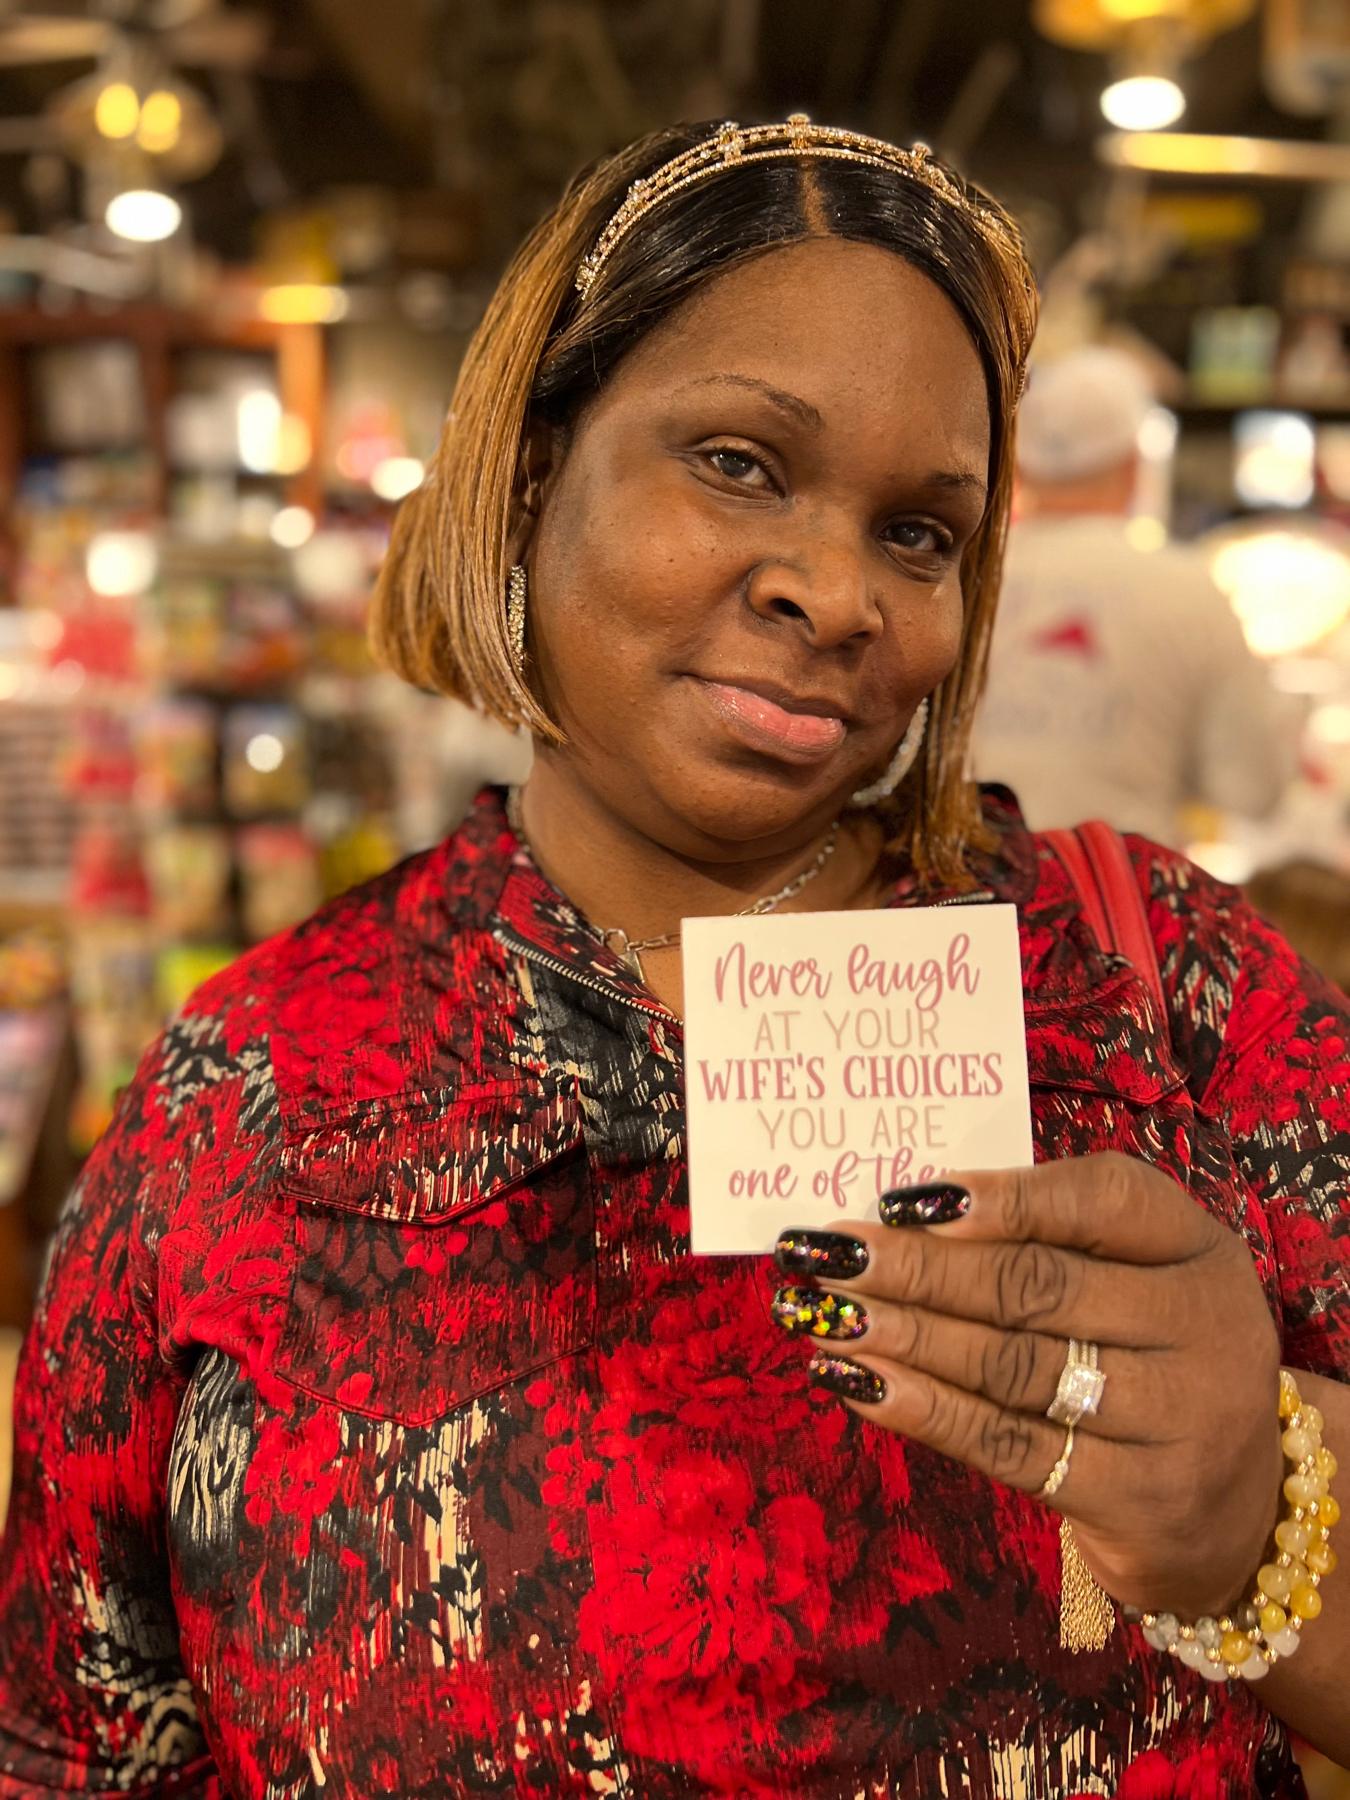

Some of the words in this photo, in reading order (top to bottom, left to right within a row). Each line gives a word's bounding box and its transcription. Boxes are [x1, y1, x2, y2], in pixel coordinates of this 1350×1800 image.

[715, 943, 832, 1008] Never
[848, 933, 979, 1011] laugh
[754, 1011, 801, 1051] AT
[823, 1008, 940, 1050] YOUR
[698, 1053, 826, 1102] WIFE'S
[843, 1053, 1003, 1098] CHOICES
[758, 1108, 846, 1150] YOU
[871, 1105, 948, 1148] ARE
[729, 1165, 798, 1198] one
[812, 1151, 860, 1207] of
[874, 1147, 952, 1198] the
